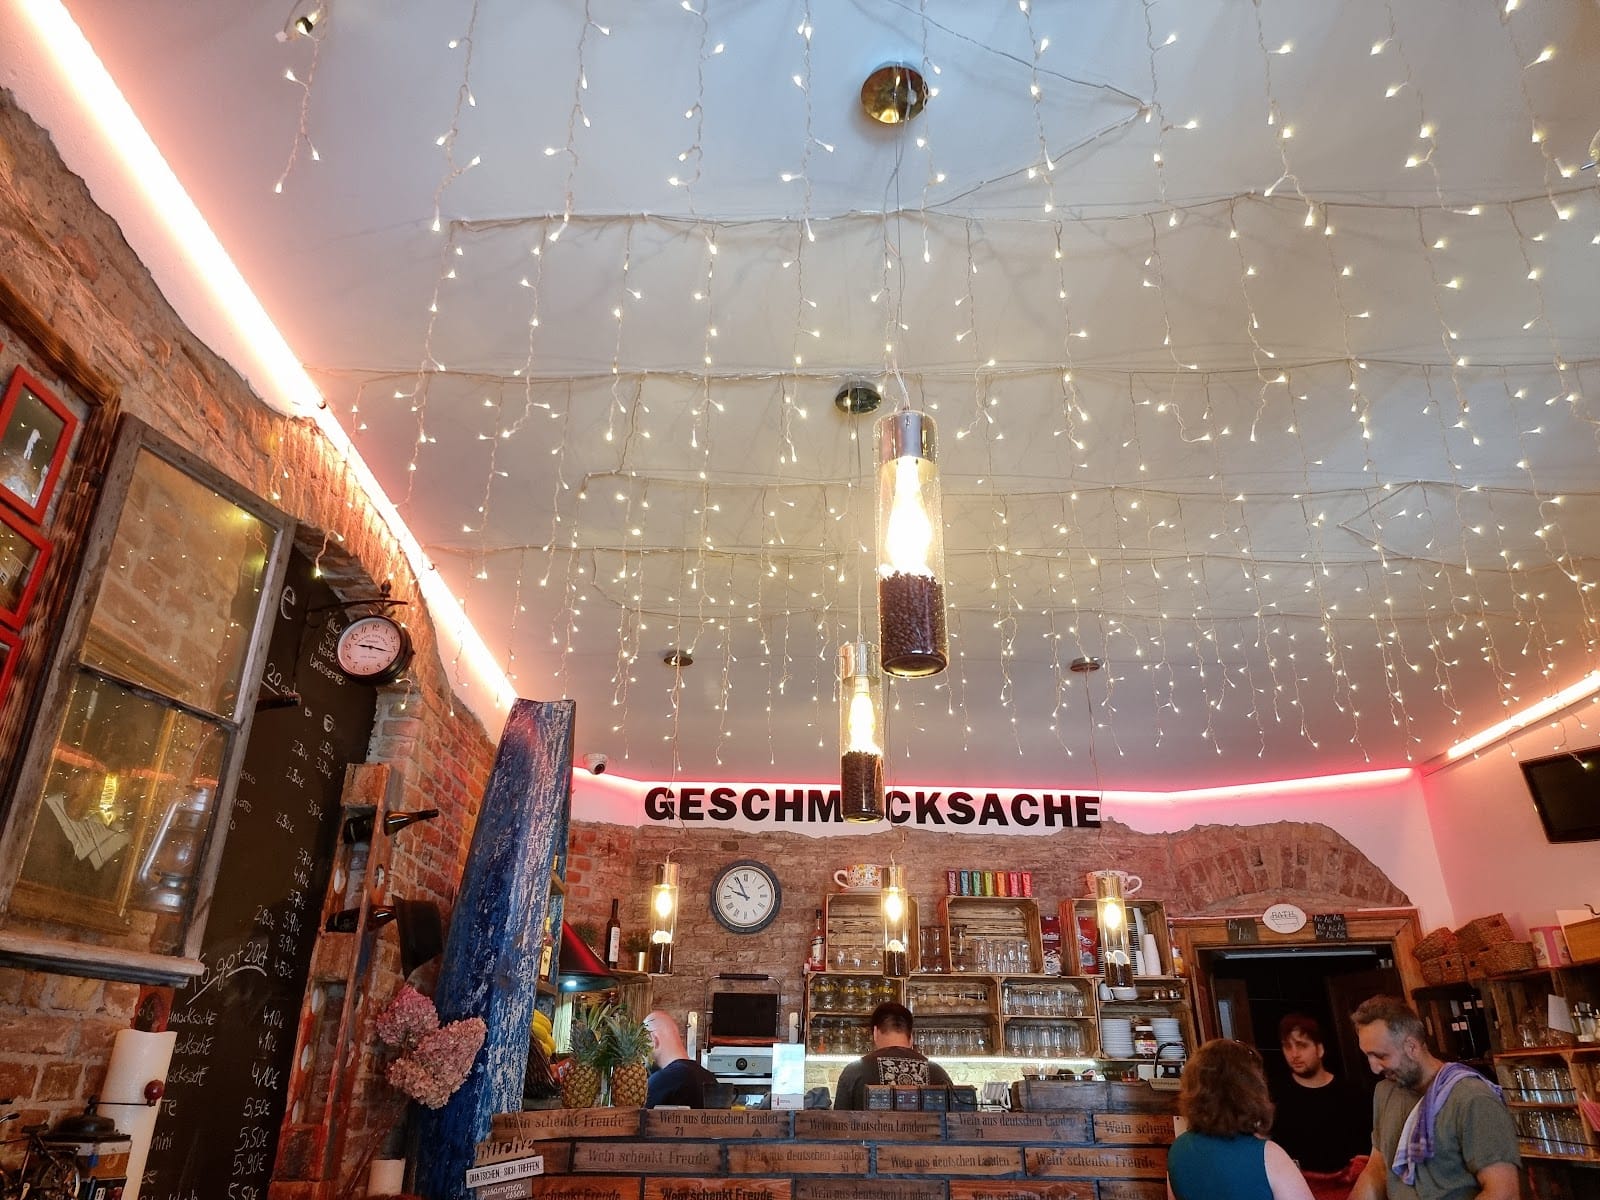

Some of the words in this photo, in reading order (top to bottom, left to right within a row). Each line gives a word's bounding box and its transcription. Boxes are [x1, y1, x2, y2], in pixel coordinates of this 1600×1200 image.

[644, 786, 1101, 828] GESCHMCKSACHE
[243, 1097, 271, 1118] 5,50€
[536, 1114, 579, 1128] schenkt
[584, 1114, 624, 1128] Freude
[660, 1112, 681, 1124] Wein
[683, 1114, 698, 1124] aus
[700, 1112, 744, 1125] deutschen
[746, 1112, 778, 1124] Landen
[810, 1118, 832, 1131] Wein
[850, 1118, 894, 1132] deutschen
[896, 1120, 928, 1132] Landen
[958, 1114, 980, 1126] Wein
[1000, 1114, 1042, 1127] deutschen
[1104, 1120, 1131, 1134] Wein
[234, 1126, 269, 1152] 5,50€
[588, 1150, 615, 1163] Wein
[618, 1150, 663, 1163] schenkt
[892, 1156, 912, 1168] Wein
[932, 1156, 976, 1167] deutschen
[1036, 1152, 1062, 1166] Wein
[232, 1152, 267, 1176] 5,90€
